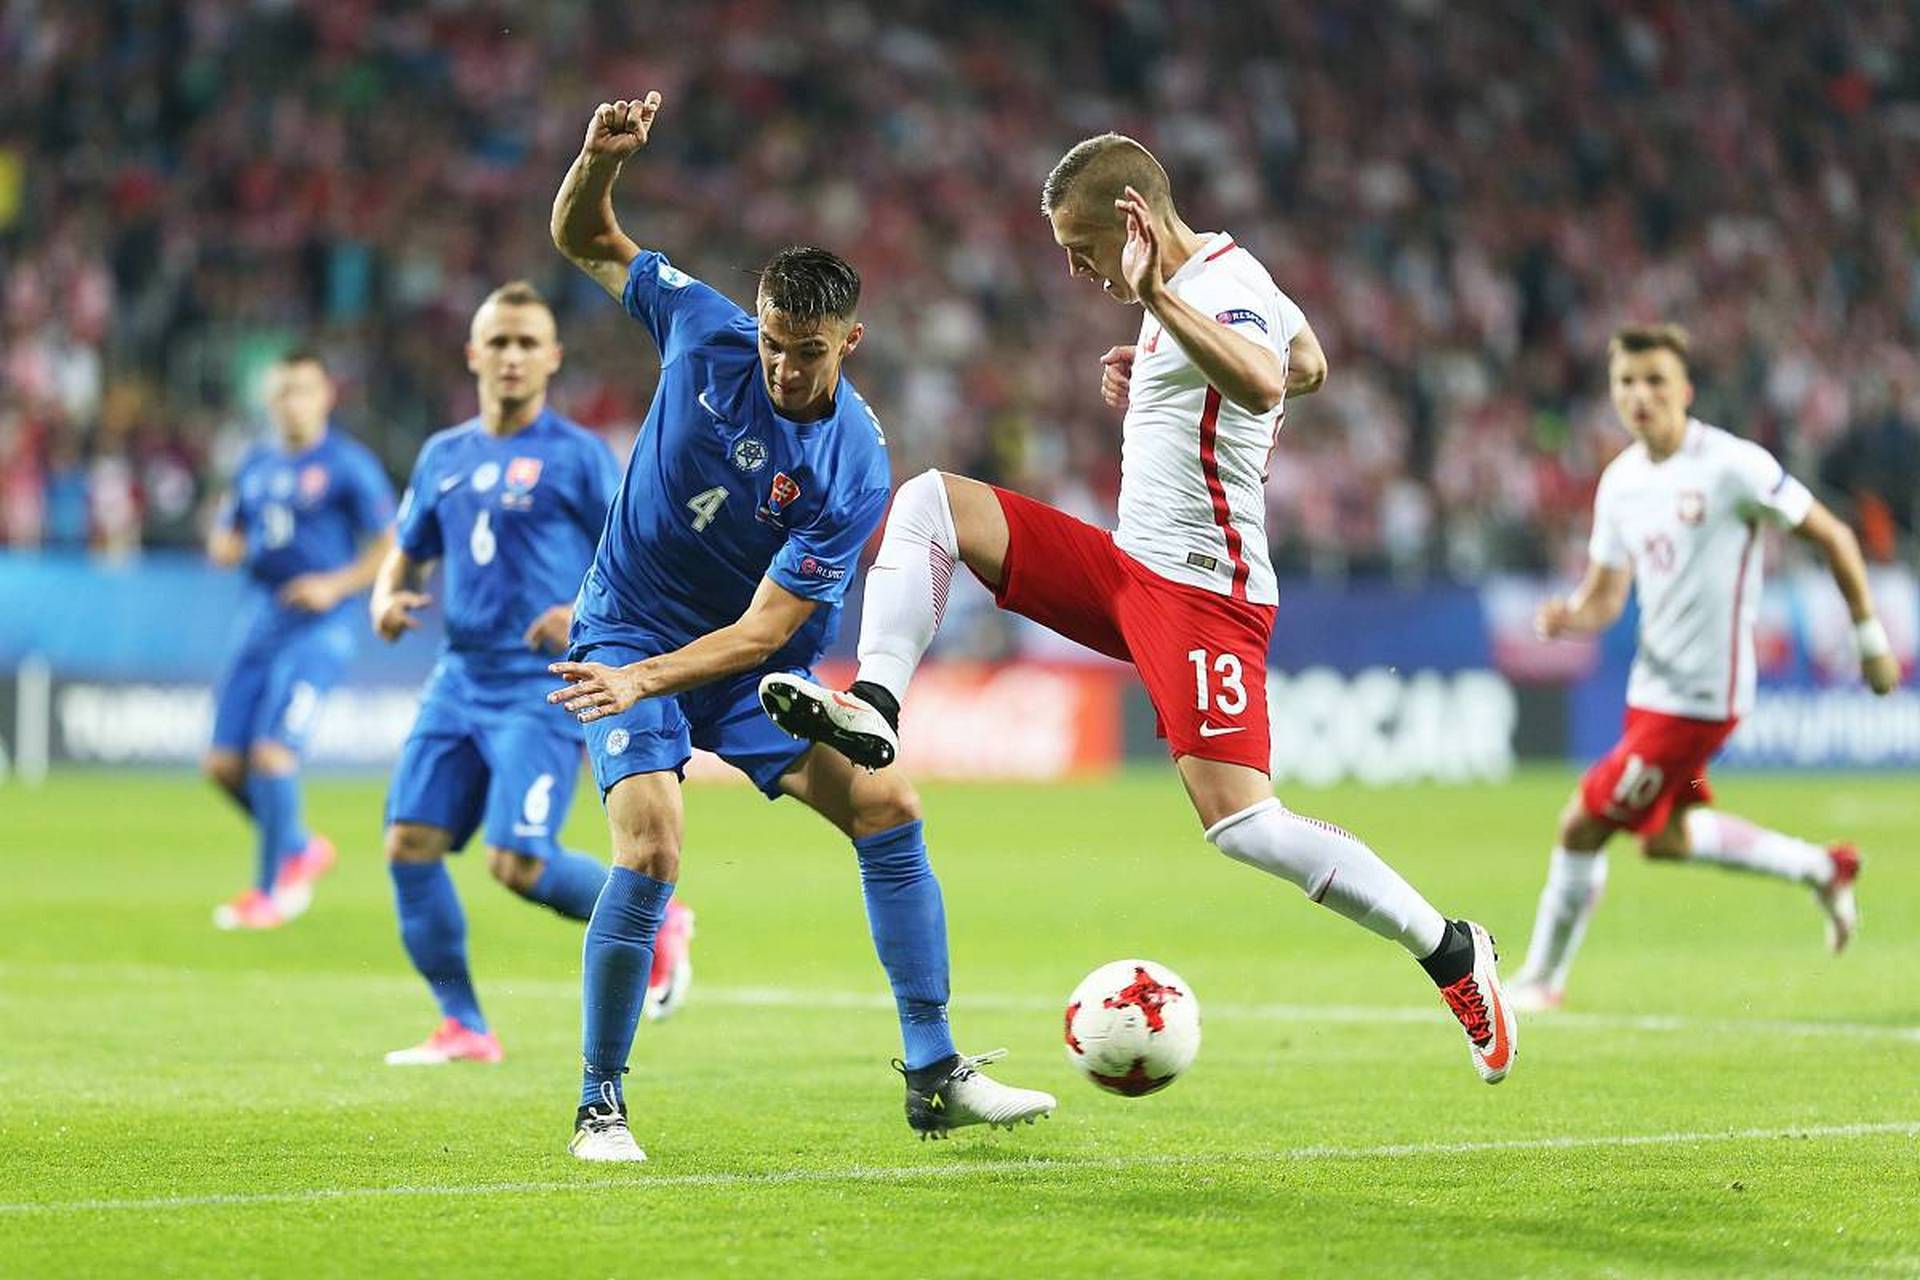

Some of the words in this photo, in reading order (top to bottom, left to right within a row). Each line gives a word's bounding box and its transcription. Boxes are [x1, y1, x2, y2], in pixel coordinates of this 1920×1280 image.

[686, 485, 730, 533] 4
[470, 510, 497, 567] 6
[1188, 648, 1248, 716] 13
[523, 773, 554, 825] 6
[1614, 753, 1665, 811] 10
